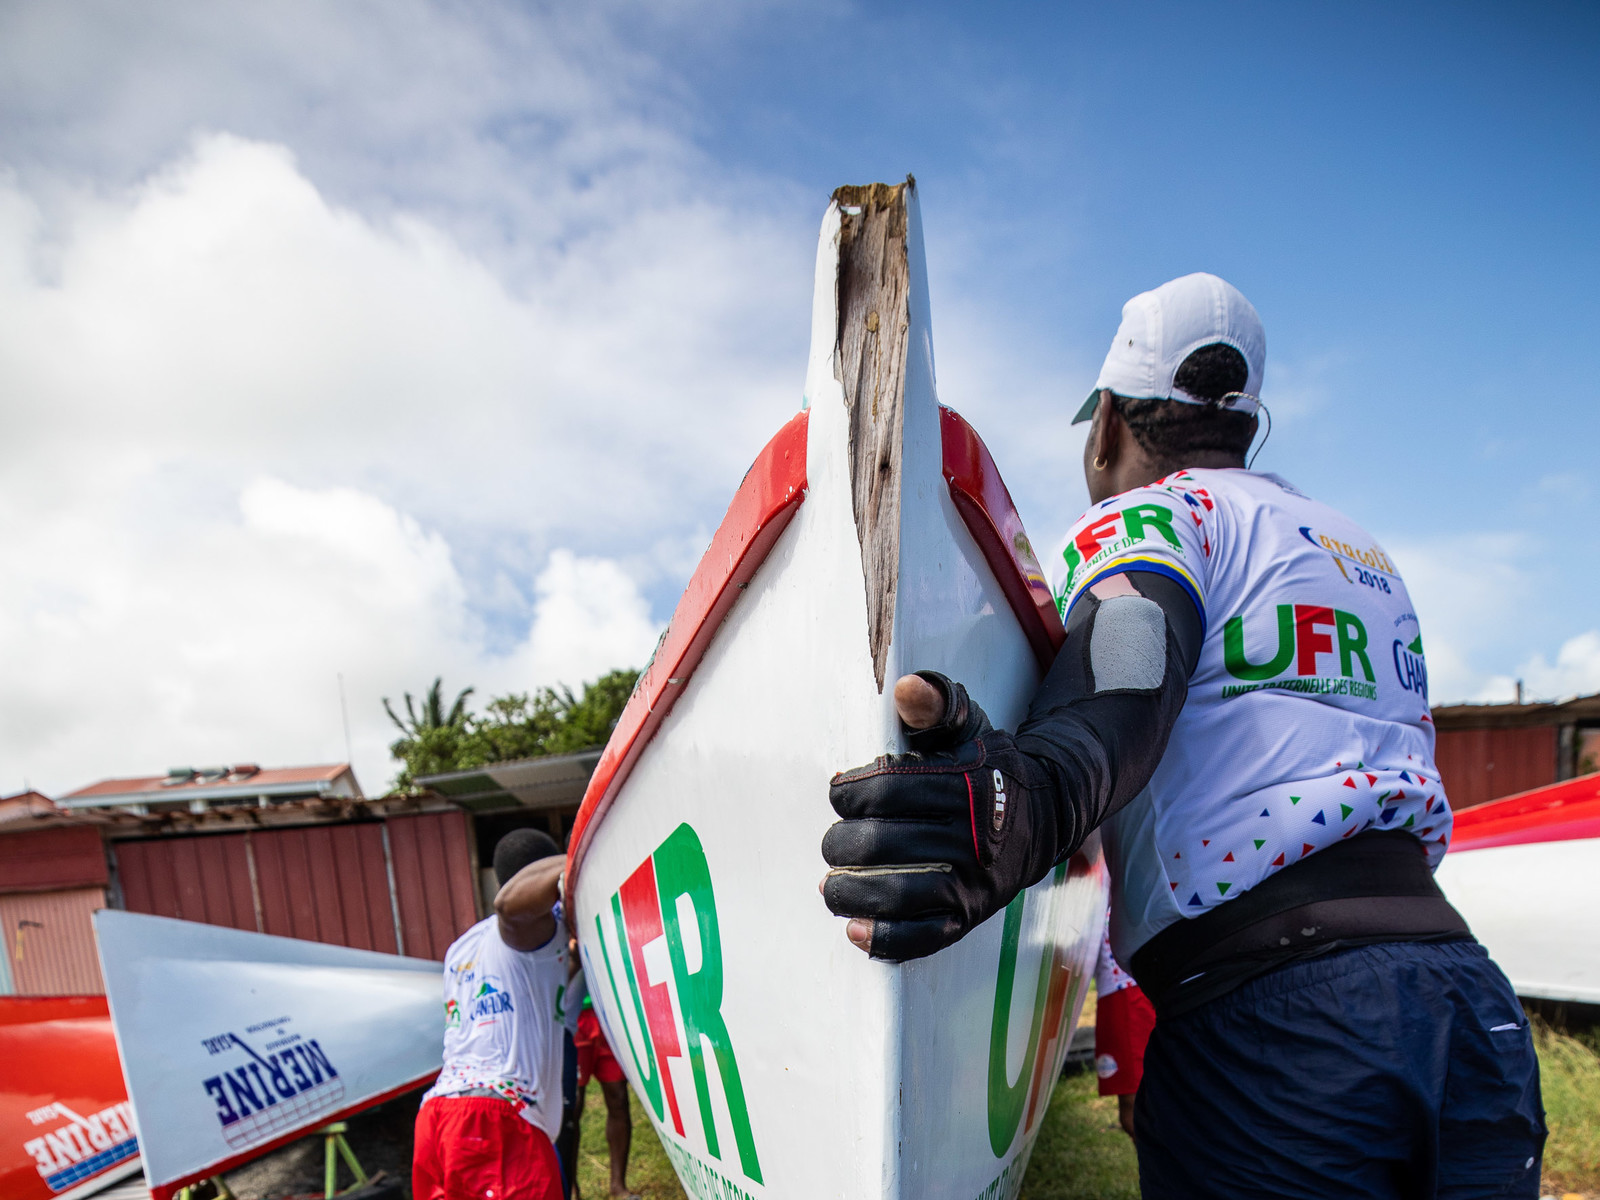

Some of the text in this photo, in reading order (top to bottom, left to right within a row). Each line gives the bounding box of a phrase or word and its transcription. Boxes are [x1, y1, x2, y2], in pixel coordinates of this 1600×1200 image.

[1354, 566, 1392, 595] 2018
[1223, 603, 1377, 682] UFR
[1261, 678, 1331, 694] FRATERNELLE
[1332, 678, 1349, 695] DES
[993, 769, 1007, 816] Gil
[595, 822, 765, 1187] UFR
[203, 1034, 338, 1126] MERINE
